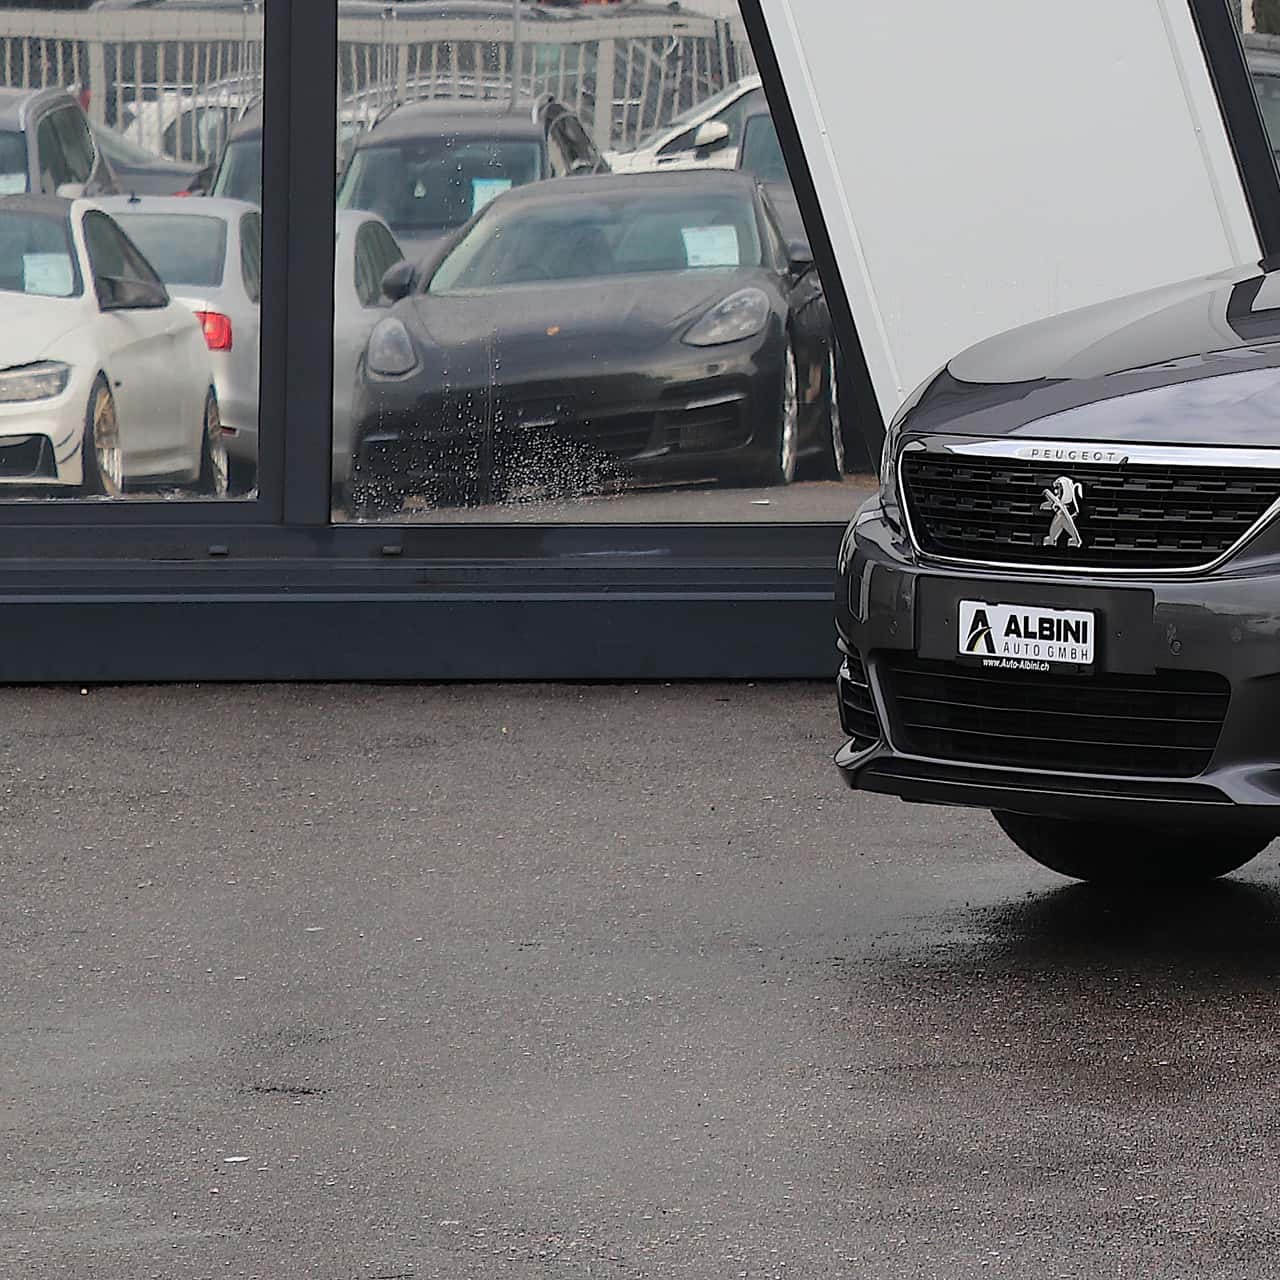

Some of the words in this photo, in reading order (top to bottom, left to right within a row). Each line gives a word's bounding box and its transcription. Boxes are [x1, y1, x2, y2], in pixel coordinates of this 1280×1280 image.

[1031, 448, 1116, 462] PEUGEOT
[1004, 614, 1088, 644] ALBINI
[1003, 642, 1041, 657] AUTO
[1047, 646, 1088, 660] GMBH
[982, 658, 1050, 672] www.Auto-Albini.ch
